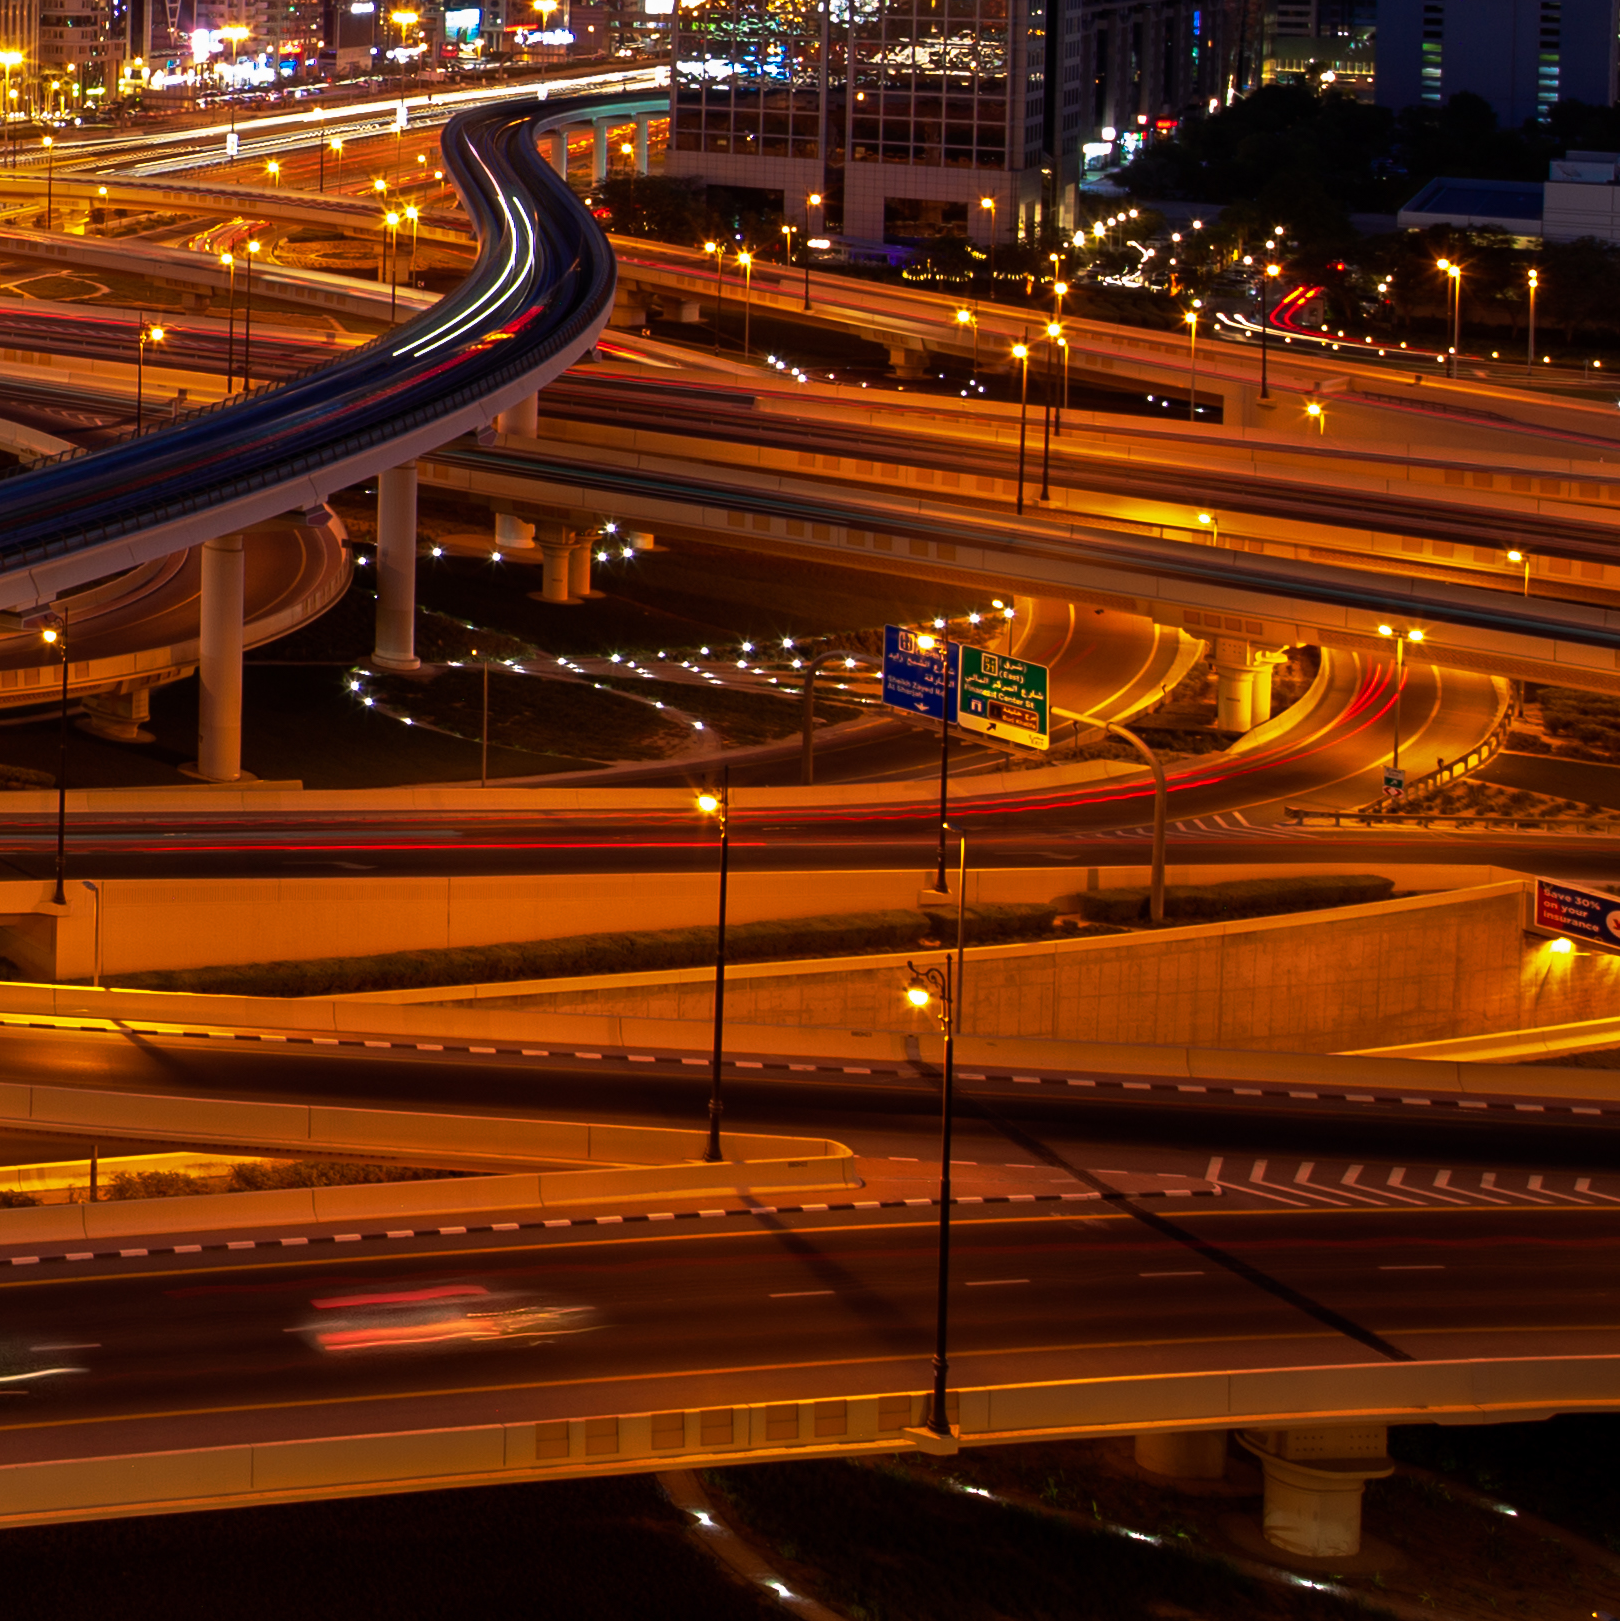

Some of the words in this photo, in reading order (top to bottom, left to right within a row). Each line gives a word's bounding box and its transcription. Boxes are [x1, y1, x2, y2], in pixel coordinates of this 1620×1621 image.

[999, 670, 1025, 684] (East)
[998, 692, 1024, 706] Center
[1544, 889, 1572, 902] Save
[1575, 896, 1601, 910] 30%
[1543, 900, 1558, 909] on
[1561, 905, 1588, 917] your
